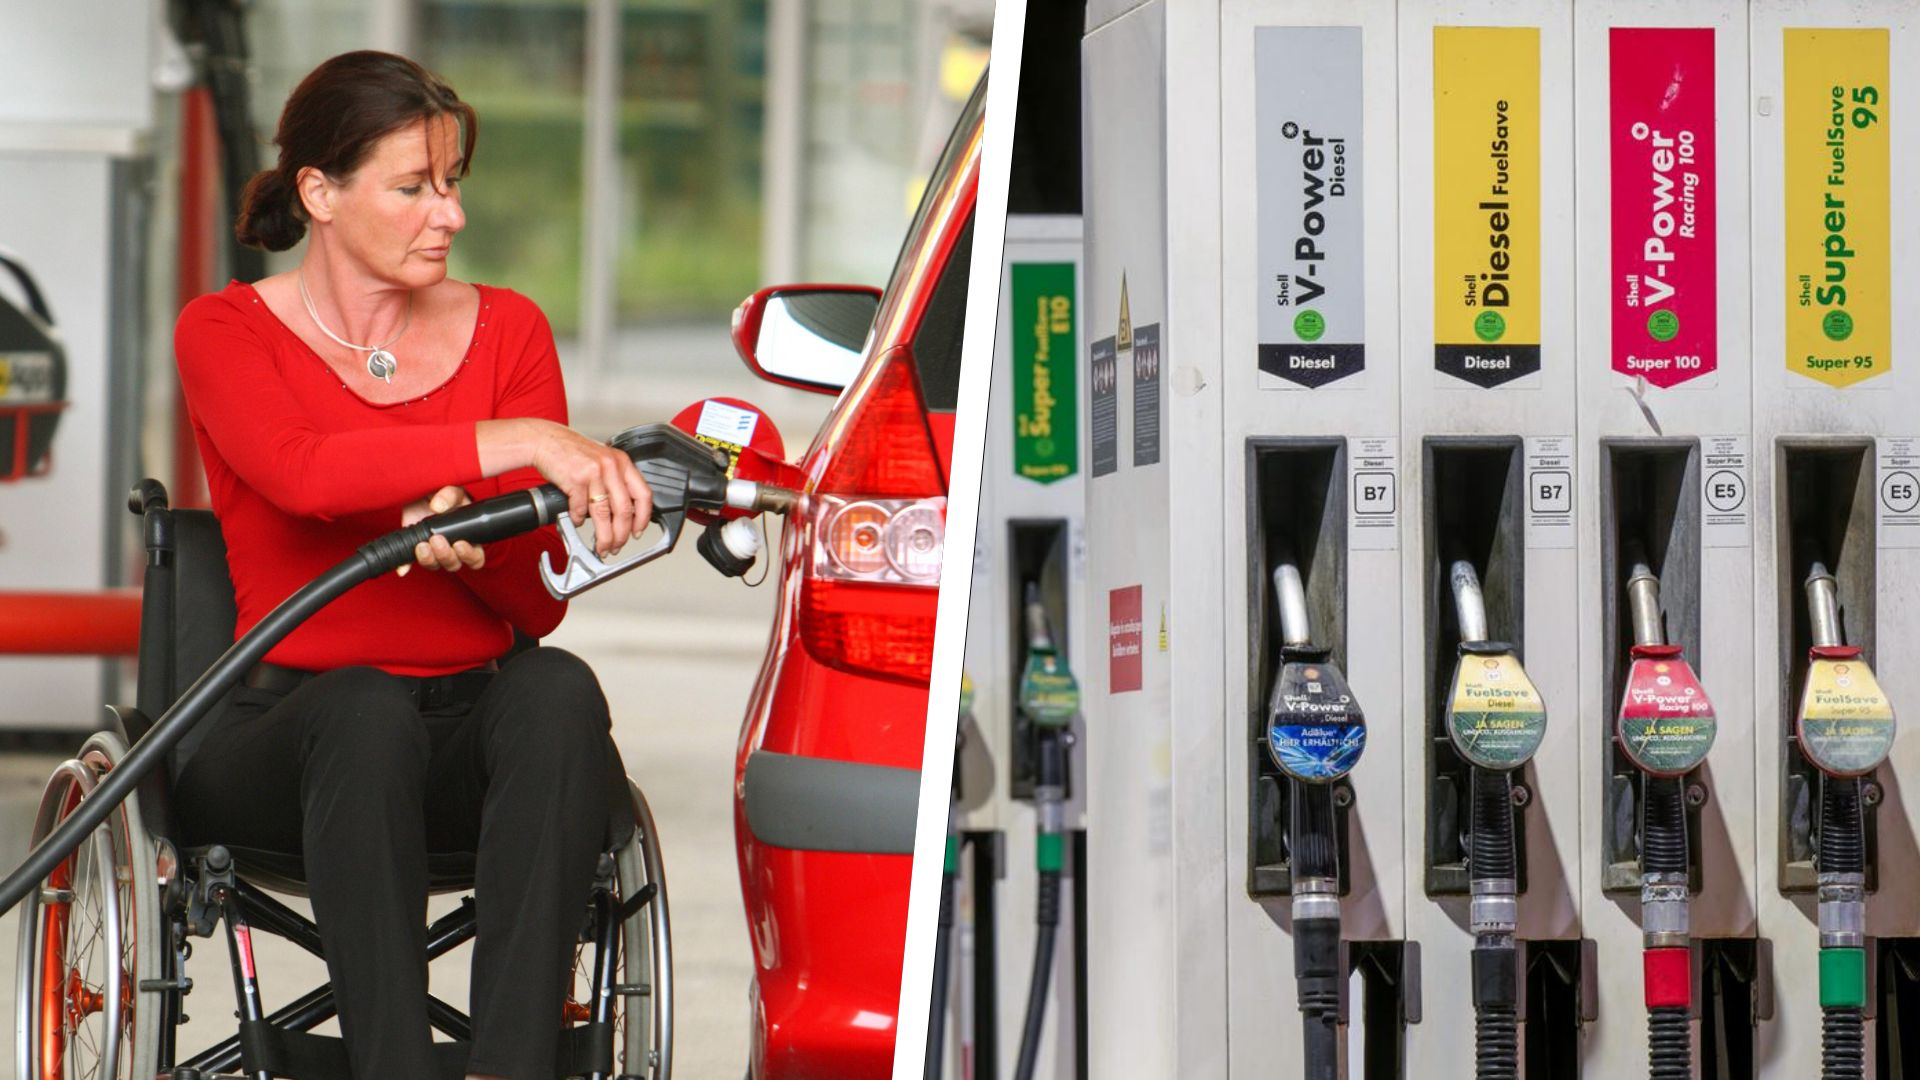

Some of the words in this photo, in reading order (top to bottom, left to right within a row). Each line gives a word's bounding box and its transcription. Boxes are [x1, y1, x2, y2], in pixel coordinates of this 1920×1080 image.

[1852, 86, 1878, 129] 95
[1491, 100, 1509, 195] FuelSave
[1679, 131, 1695, 164] 100
[1826, 86, 1845, 186] FuelSave
[1328, 138, 1345, 197] Diesel
[1679, 171, 1699, 238] Racing
[1295, 130, 1325, 306] V-Power
[1644, 130, 1675, 306] V-Power
[1479, 202, 1510, 307] Diesel
[1816, 193, 1855, 306] Super
[1278, 274, 1289, 306] Shell
[1465, 274, 1476, 306] Shell
[1626, 275, 1639, 307] Shell
[1800, 275, 1811, 307] Shell
[1050, 295, 1071, 334] E10
[1289, 356, 1335, 369] Diesel
[1465, 356, 1511, 369] Diesel
[1626, 356, 1671, 371] Super
[1674, 356, 1701, 368] 100
[1807, 356, 1851, 371] Super
[1853, 356, 1873, 369] 95
[1029, 362, 1056, 436] Super
[1364, 486, 1386, 501] B7
[1540, 485, 1562, 499] B7
[1715, 484, 1736, 498] E5
[1891, 485, 1912, 499] E5
[1466, 688, 1528, 697] FuelSave
[1488, 699, 1514, 708] Diesel
[1633, 695, 1691, 704] V-Power
[1816, 695, 1878, 704] FuelSave
[1285, 702, 1346, 712] V-Power
[1325, 713, 1347, 722] Diesel
[1659, 703, 1690, 713] Racing
[1691, 703, 1708, 711] 100
[1645, 726, 1656, 735] JA
[1660, 726, 1695, 735] SAGEN
